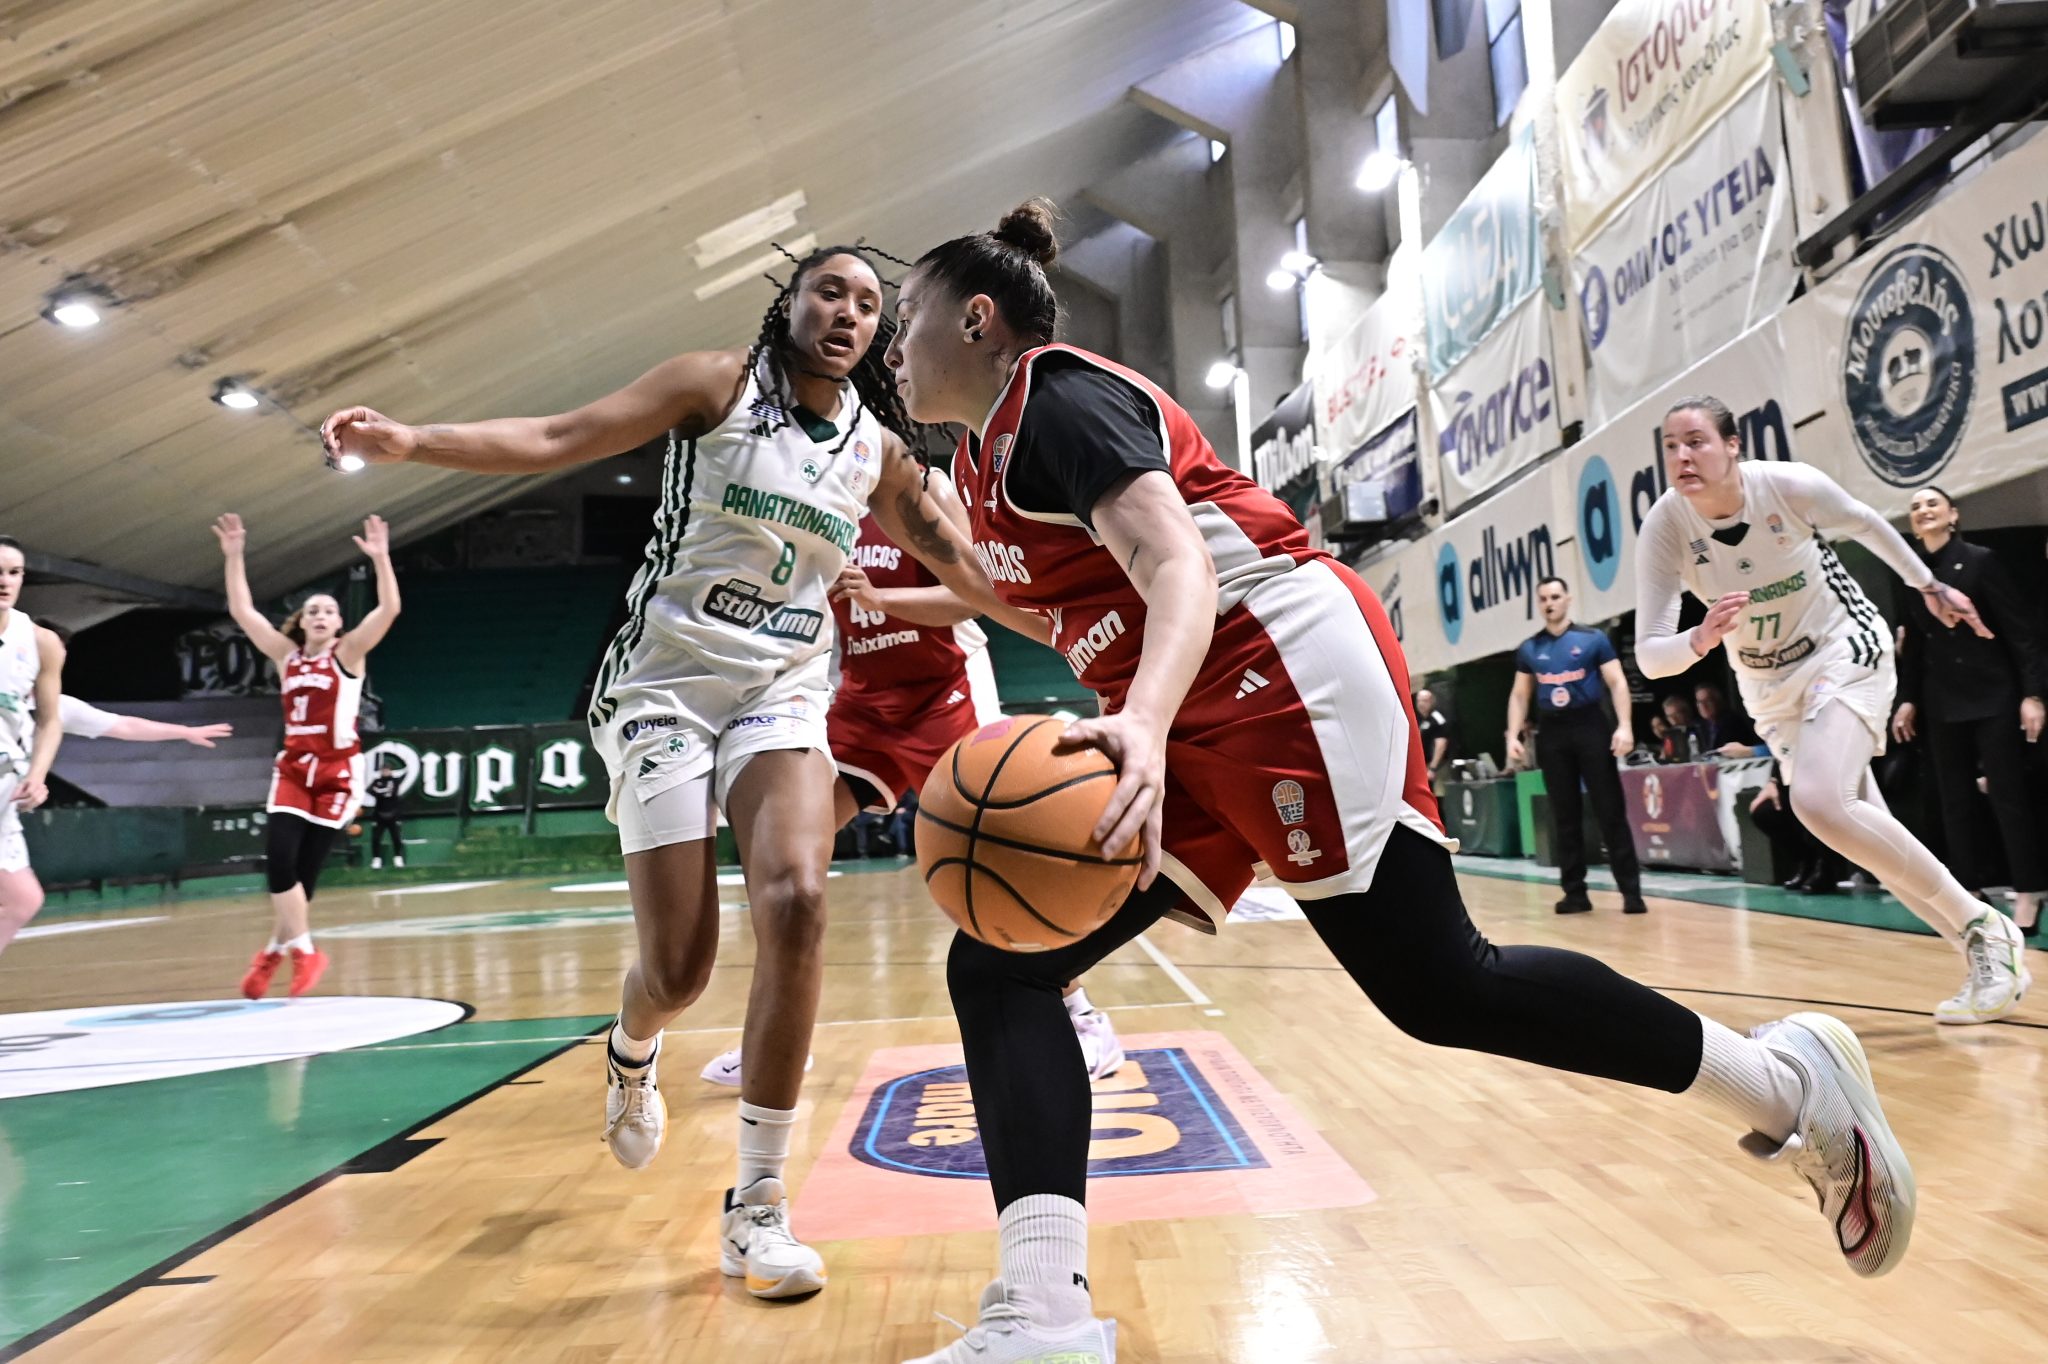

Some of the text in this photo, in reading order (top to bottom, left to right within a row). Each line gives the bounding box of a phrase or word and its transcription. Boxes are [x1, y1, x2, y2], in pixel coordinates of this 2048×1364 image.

[1695, 145, 1775, 236] ΥΓΕΙΑ
[1983, 198, 2048, 279] χω
[1994, 290, 2048, 364] λο
[771, 541, 796, 586] 8
[1470, 525, 1554, 620] allwyn
[1750, 612, 1781, 641] 77
